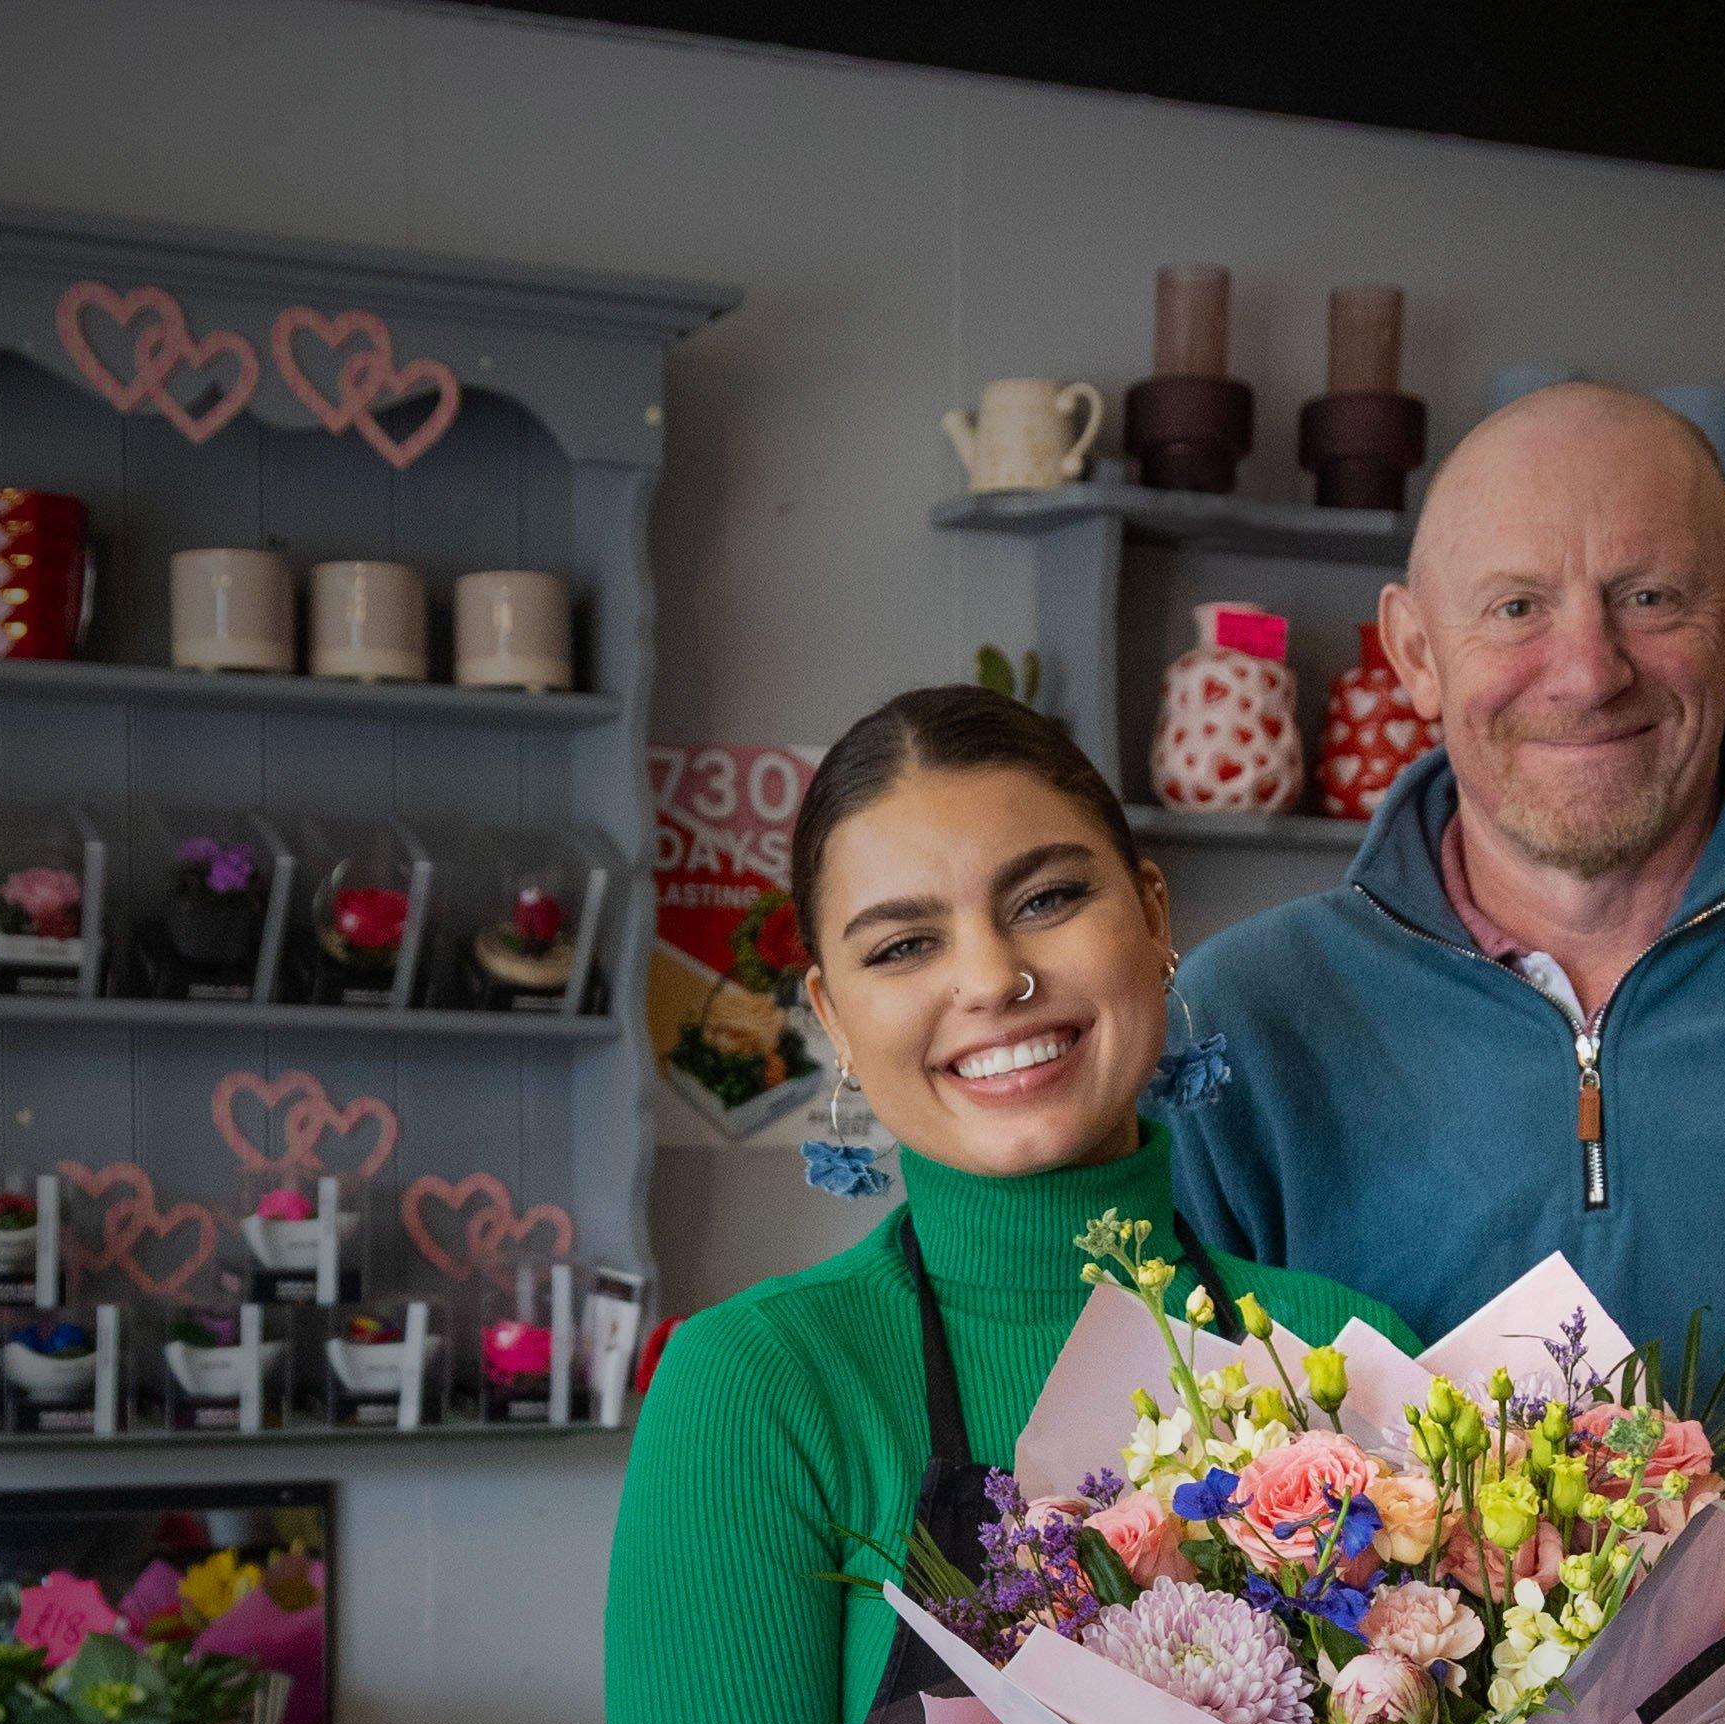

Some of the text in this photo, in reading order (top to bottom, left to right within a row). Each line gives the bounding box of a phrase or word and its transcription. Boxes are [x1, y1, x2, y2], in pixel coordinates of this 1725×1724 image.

[646, 750, 799, 821] 730
[653, 828, 790, 874] DAYS
[31, 1602, 85, 1645] £18
